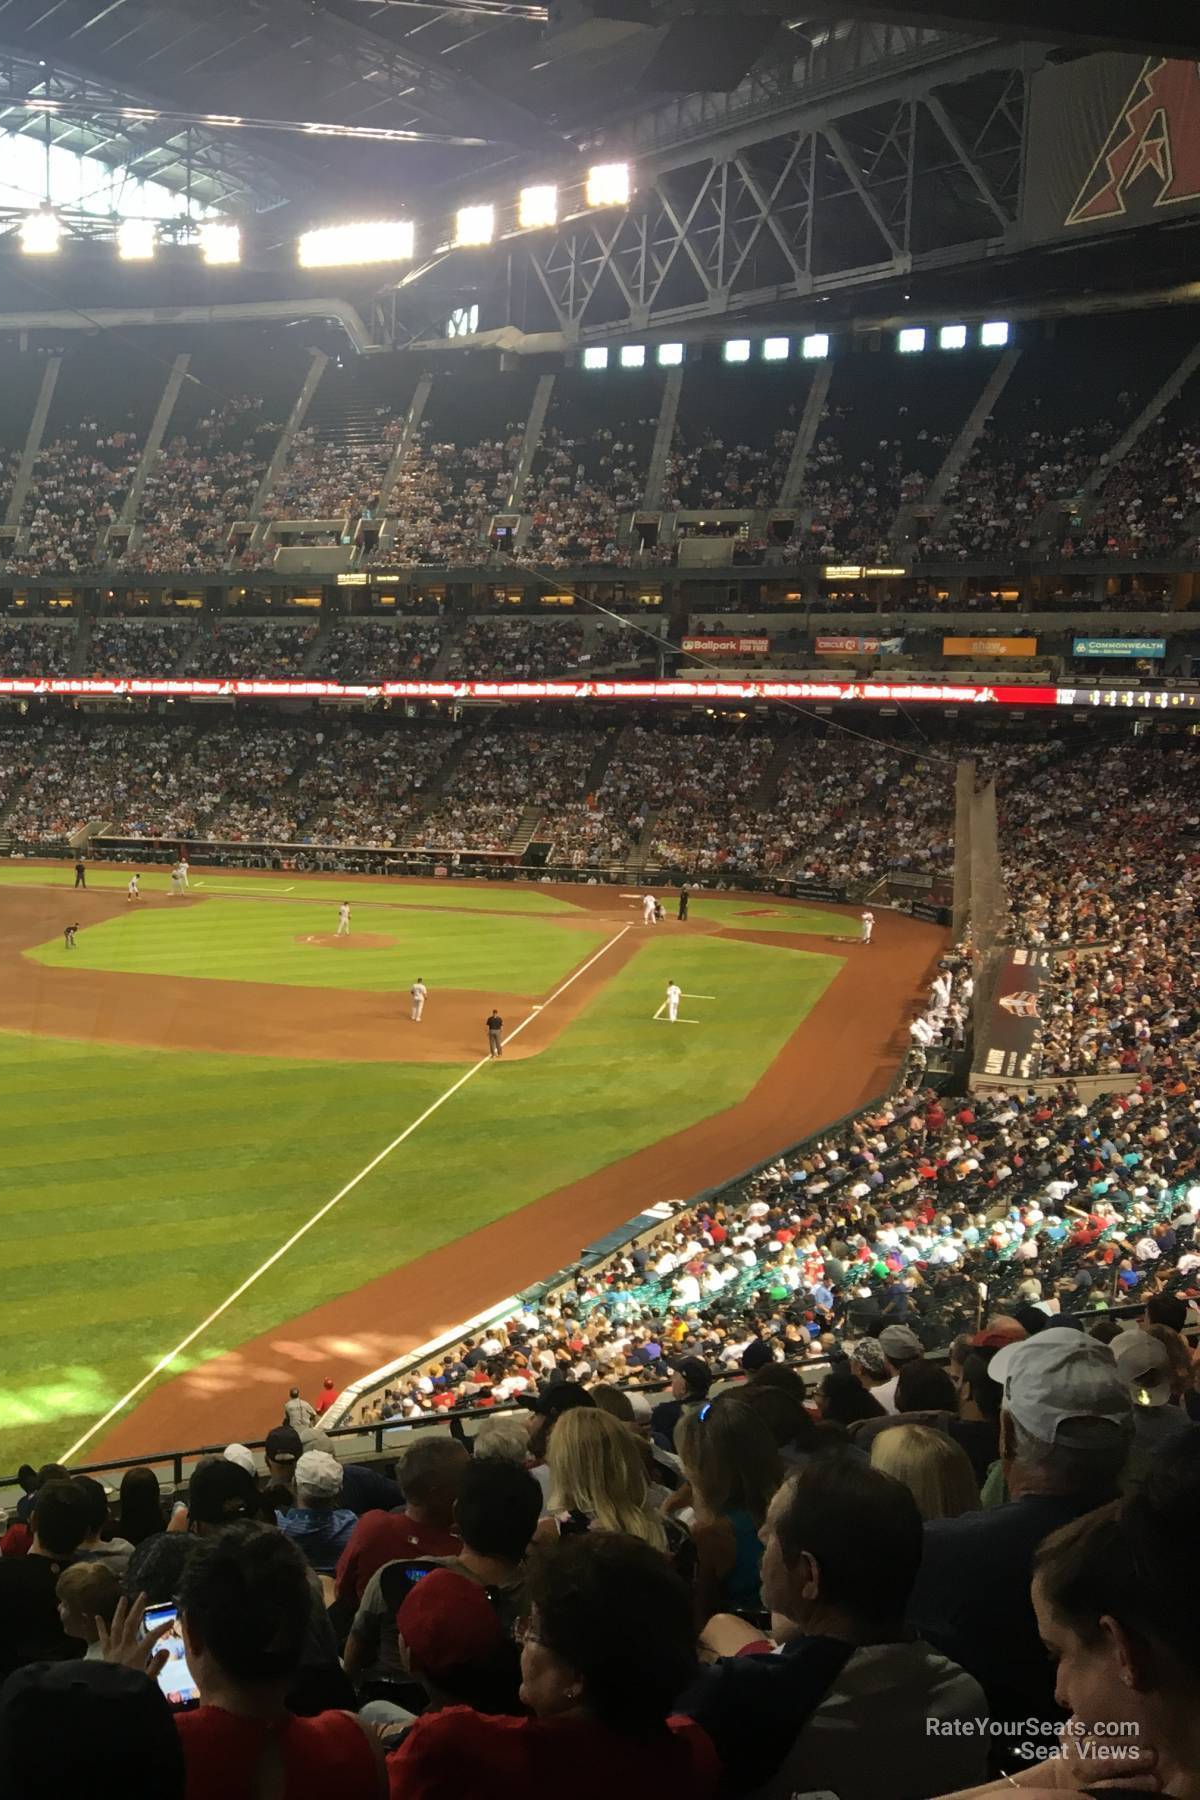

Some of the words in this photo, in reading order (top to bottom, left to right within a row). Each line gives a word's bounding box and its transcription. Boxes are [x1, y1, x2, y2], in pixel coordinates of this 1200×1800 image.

[694, 640, 737, 652] Ballpark
[818, 641, 844, 649] CIRCLE
[1088, 641, 1164, 649] COMMONWEALTH
